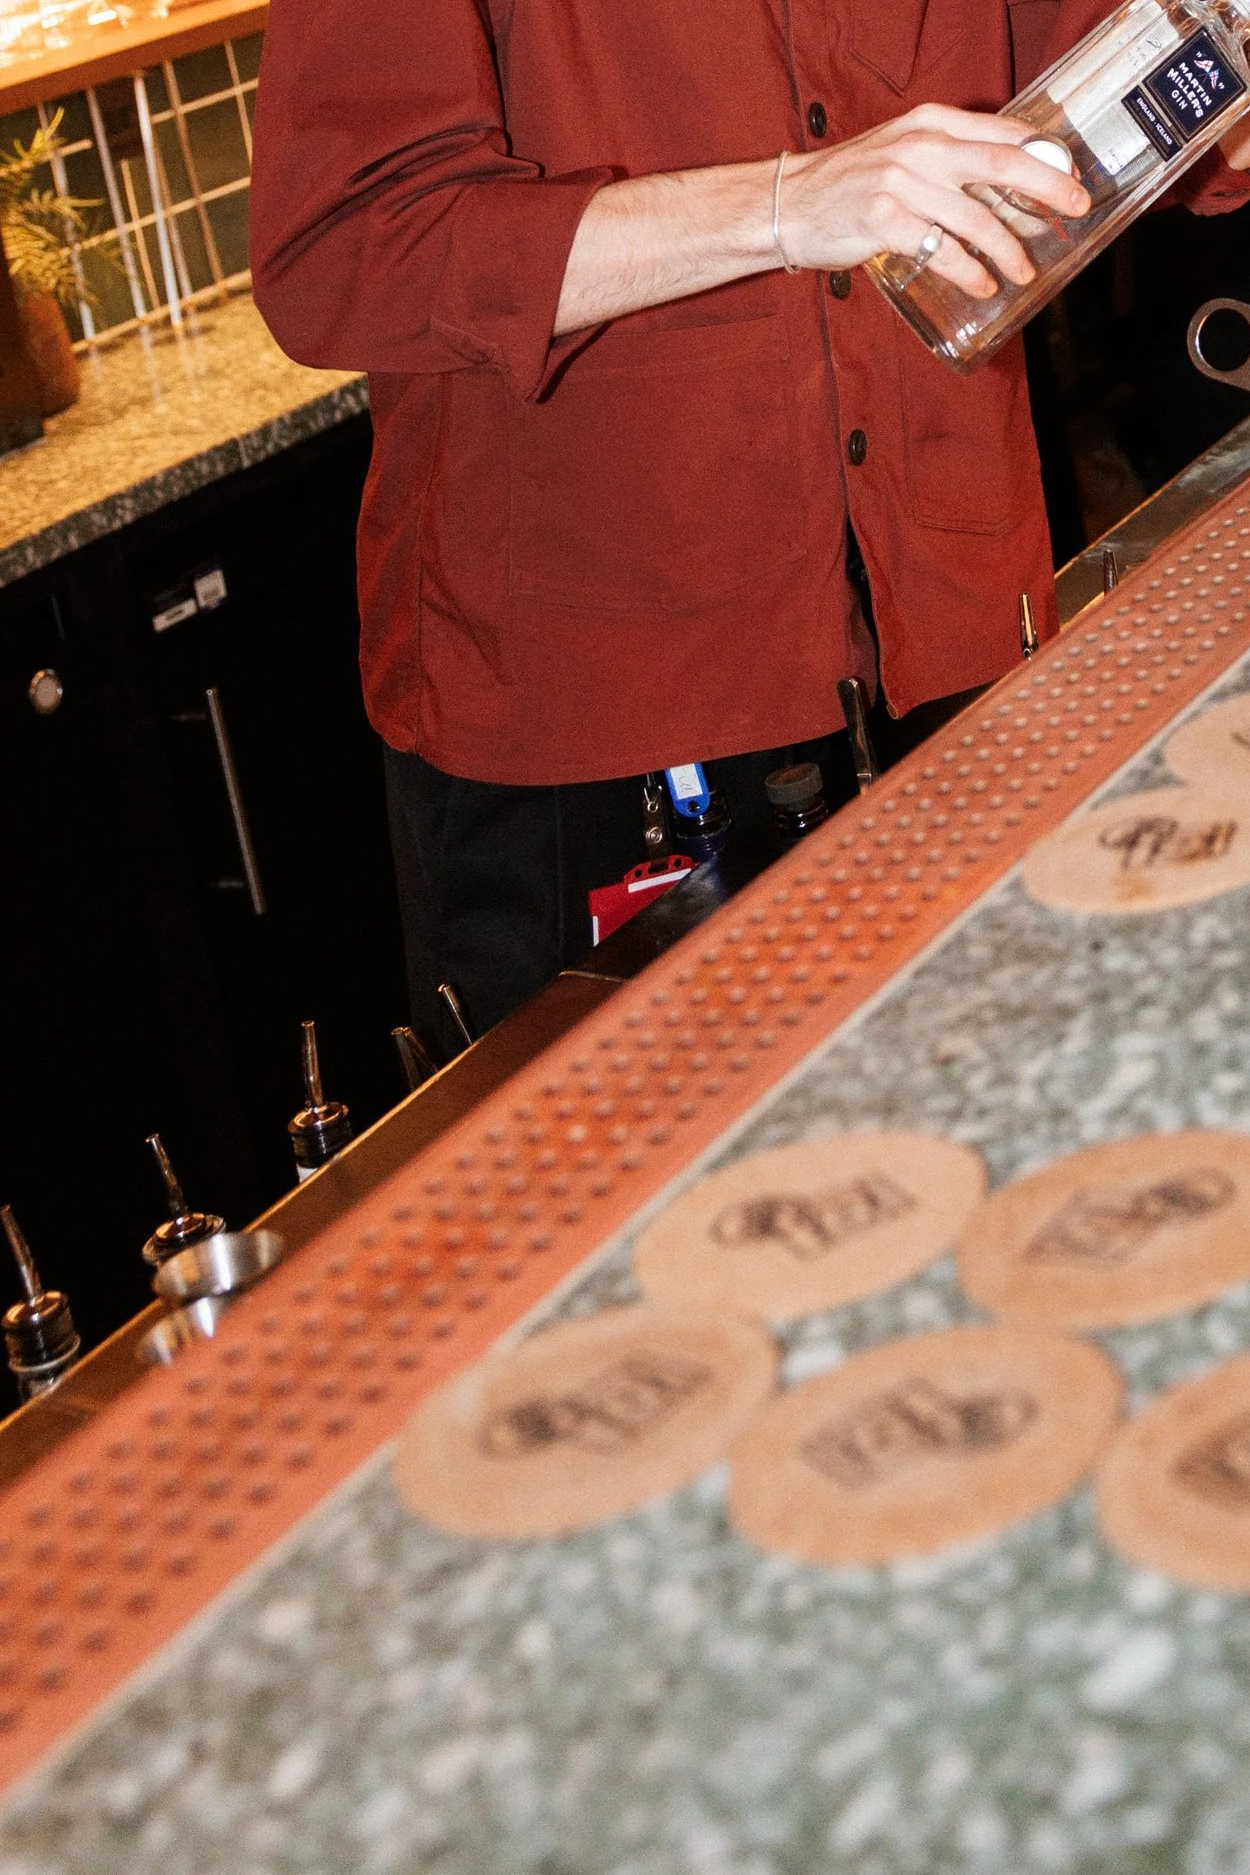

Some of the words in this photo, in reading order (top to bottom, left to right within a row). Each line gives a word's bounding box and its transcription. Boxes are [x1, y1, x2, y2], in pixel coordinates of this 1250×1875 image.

[1167, 68, 1204, 118] MILLER'S
[1171, 89, 1188, 110] GIN
[1179, 62, 1212, 106] MARTIN
[1136, 97, 1156, 121] ENGLAND
[1156, 123, 1173, 145] ICELAND
